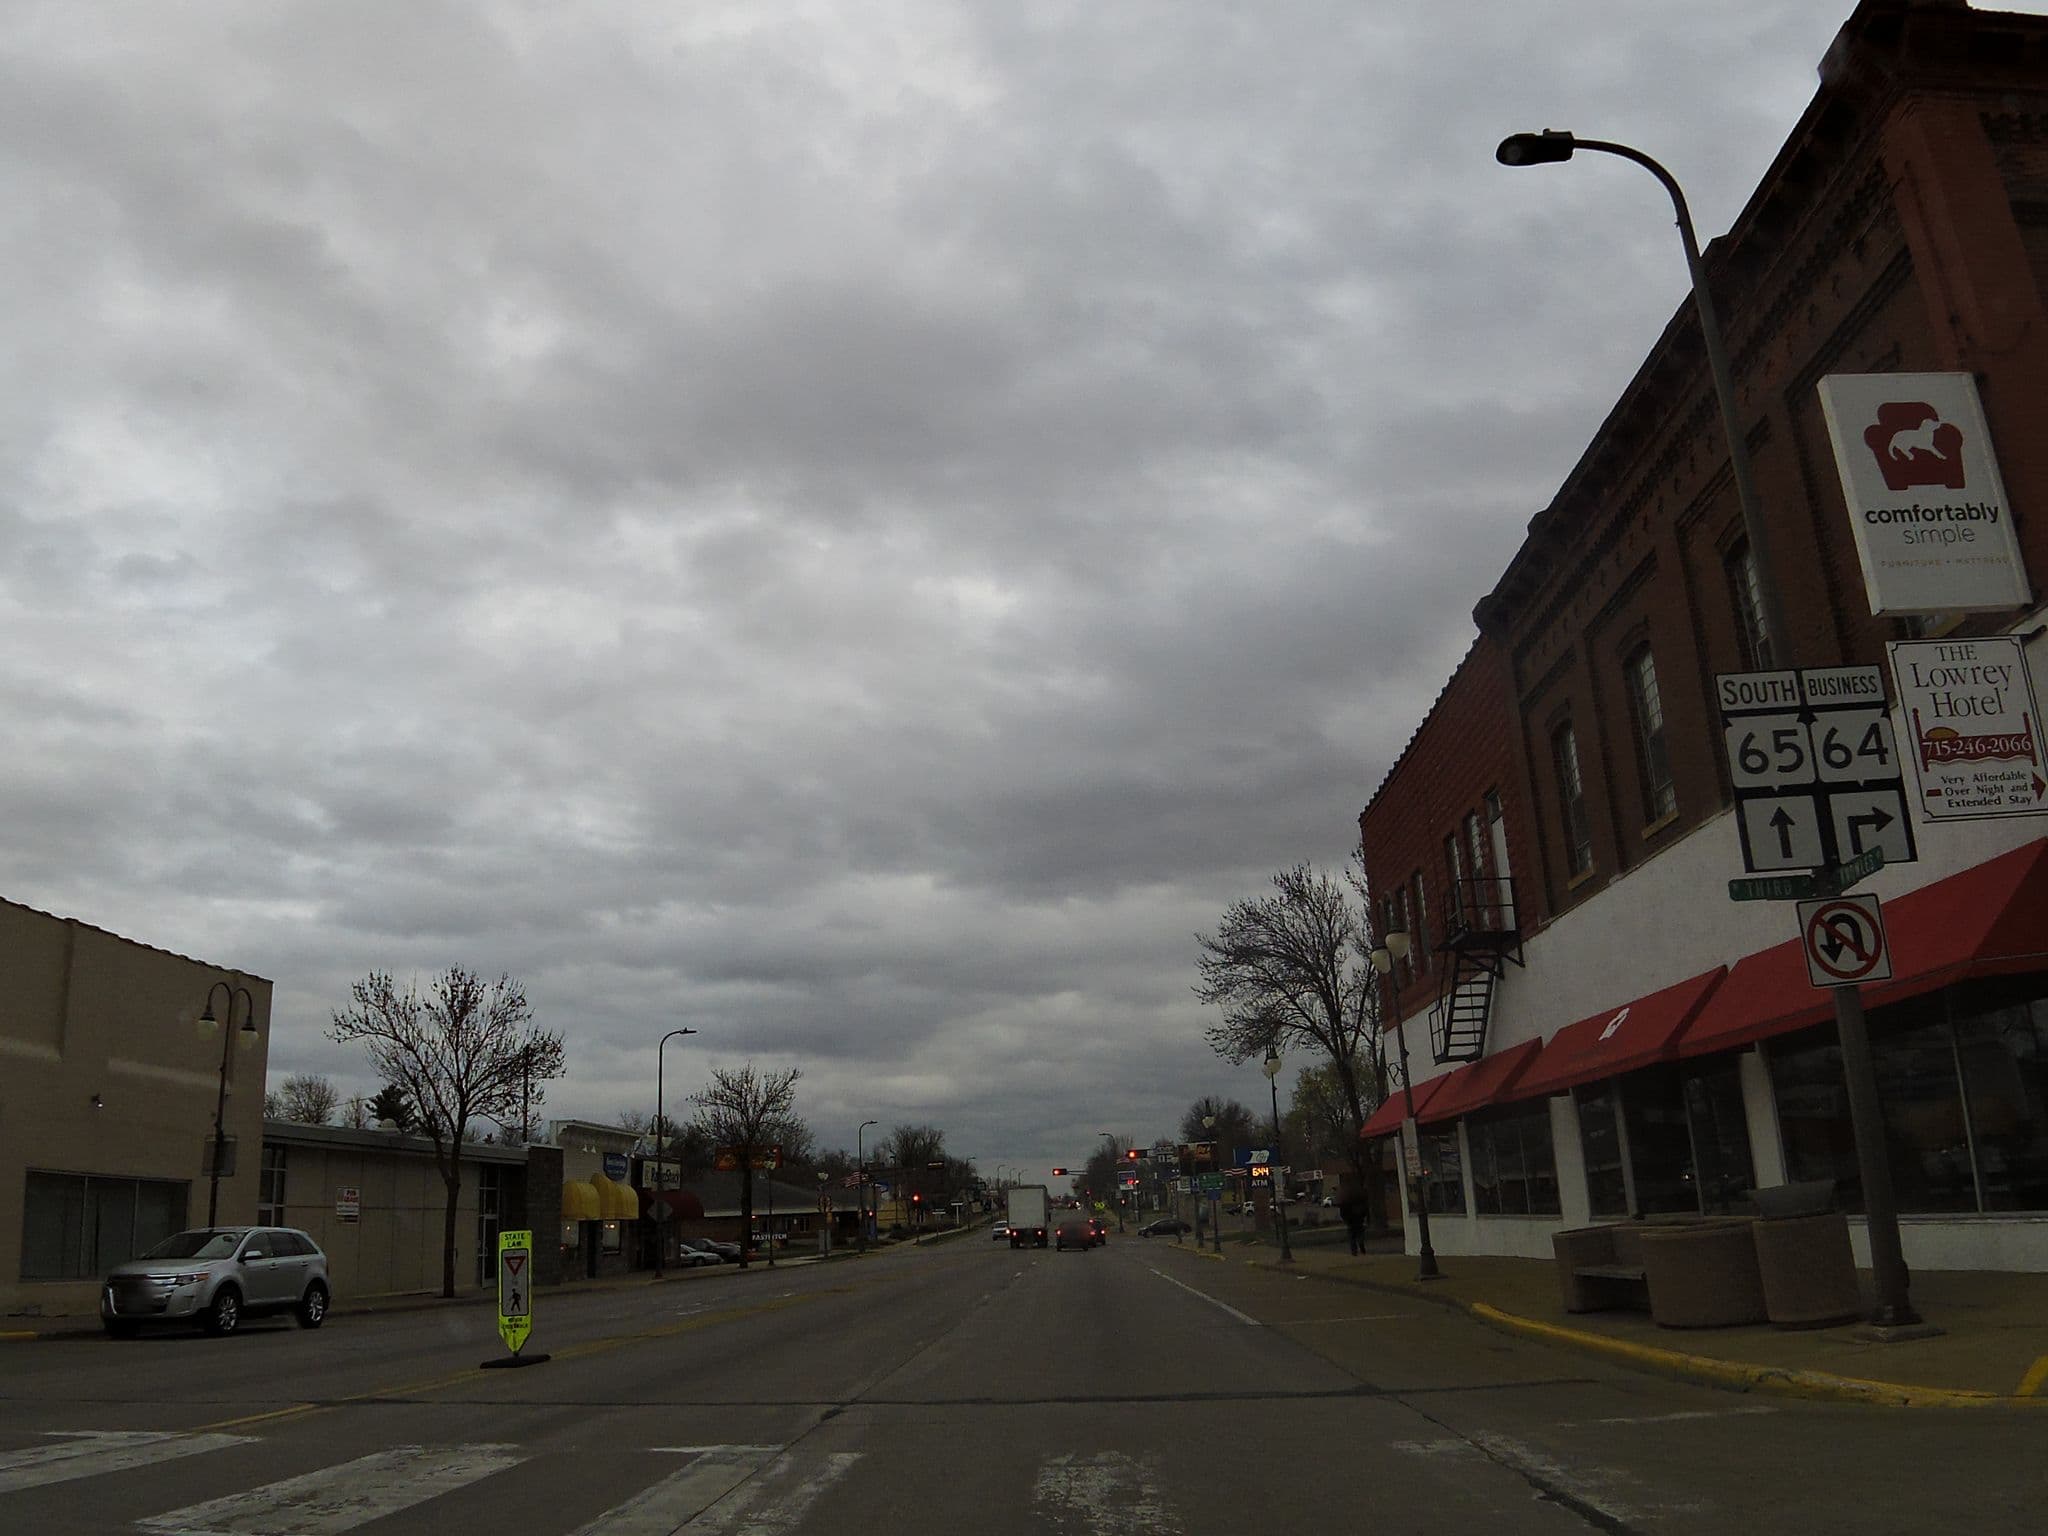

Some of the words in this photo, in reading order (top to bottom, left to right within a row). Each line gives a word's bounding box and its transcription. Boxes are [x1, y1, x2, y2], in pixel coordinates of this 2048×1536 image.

[1864, 502, 1998, 524] comfortably
[1903, 524, 1975, 546] simple
[1935, 645, 1977, 661] THE
[1808, 675, 1878, 697] BUSINESS
[1910, 662, 2011, 691] Lowrey
[1723, 679, 1797, 705] SOUTH
[1929, 688, 2005, 718] Hotel
[1739, 729, 1804, 775] 65
[1822, 722, 1888, 769] 64
[1922, 736, 2032, 758] 715-246-2066
[1940, 776, 1965, 785] Very
[1972, 771, 2026, 782] Affordable
[1944, 787, 1969, 797] Over
[1976, 784, 2004, 796] Night
[2010, 783, 2028, 792] and
[1948, 796, 2001, 808] Extended
[2009, 794, 2032, 805] Stay
[1744, 879, 1792, 897] THIRD
[1252, 1179, 1267, 1187] ATM
